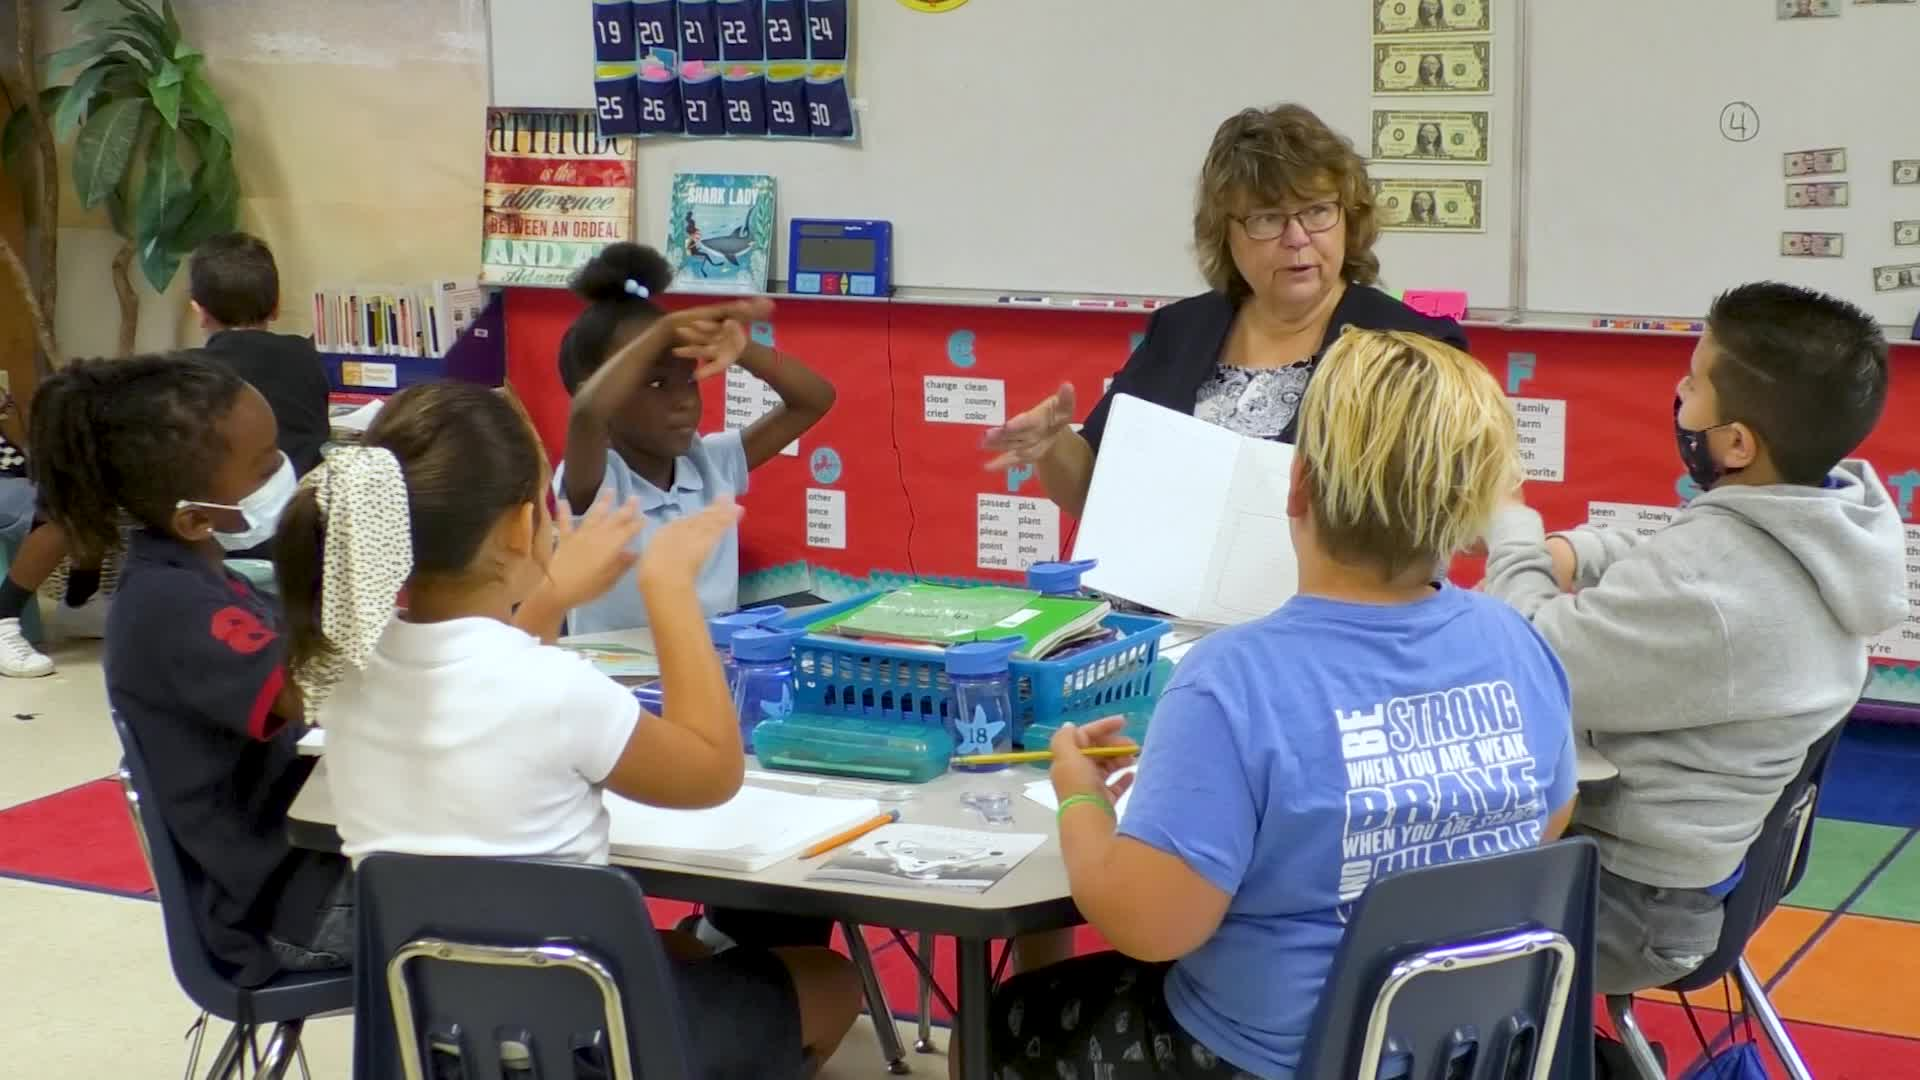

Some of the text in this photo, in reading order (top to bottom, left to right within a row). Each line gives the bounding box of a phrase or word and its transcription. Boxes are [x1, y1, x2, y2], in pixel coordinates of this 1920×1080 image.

[597, 17, 832, 45] 19 20 21 22 23 24
[598, 96, 831, 127] 25 26 27 28 29 30
[1729, 111, 1747, 138] 4
[501, 187, 616, 213] difference
[687, 185, 760, 206] SHARK LADY
[491, 217, 621, 238] BETWEEN AN ORDEAL
[486, 239, 561, 266] AND
[1507, 352, 1536, 393] F
[926, 380, 958, 391] change
[964, 383, 988, 392] clean
[727, 392, 752, 404] began
[927, 394, 948, 403] close
[964, 397, 997, 407] country
[727, 407, 752, 417] better
[927, 408, 949, 418] cried
[1516, 402, 1550, 415] family
[964, 411, 987, 420] color
[1516, 418, 1542, 429] farm
[1516, 433, 1537, 444] fine
[808, 494, 832, 502] other
[979, 499, 1011, 509] passed
[1018, 501, 1036, 511] pick
[808, 508, 829, 516] once
[979, 511, 1000, 522] plan
[1590, 507, 1616, 517] seen
[1638, 510, 1673, 524] slowly
[808, 520, 832, 530] order
[1018, 515, 1041, 526] plant
[979, 526, 1008, 538] please
[1018, 531, 1044, 541] poem
[808, 535, 831, 546] open
[979, 541, 1003, 551] point
[1018, 545, 1038, 554] pole
[979, 556, 1008, 567] pulled
[1387, 680, 1523, 752] STRONG
[968, 727, 988, 745] 18
[1335, 703, 1389, 759] BE
[1346, 733, 1529, 788] WHEN YOU ARE WEAK
[1343, 828, 1396, 859] WHEN
[1401, 823, 1439, 846] YOU
[1440, 816, 1476, 838] ARE
